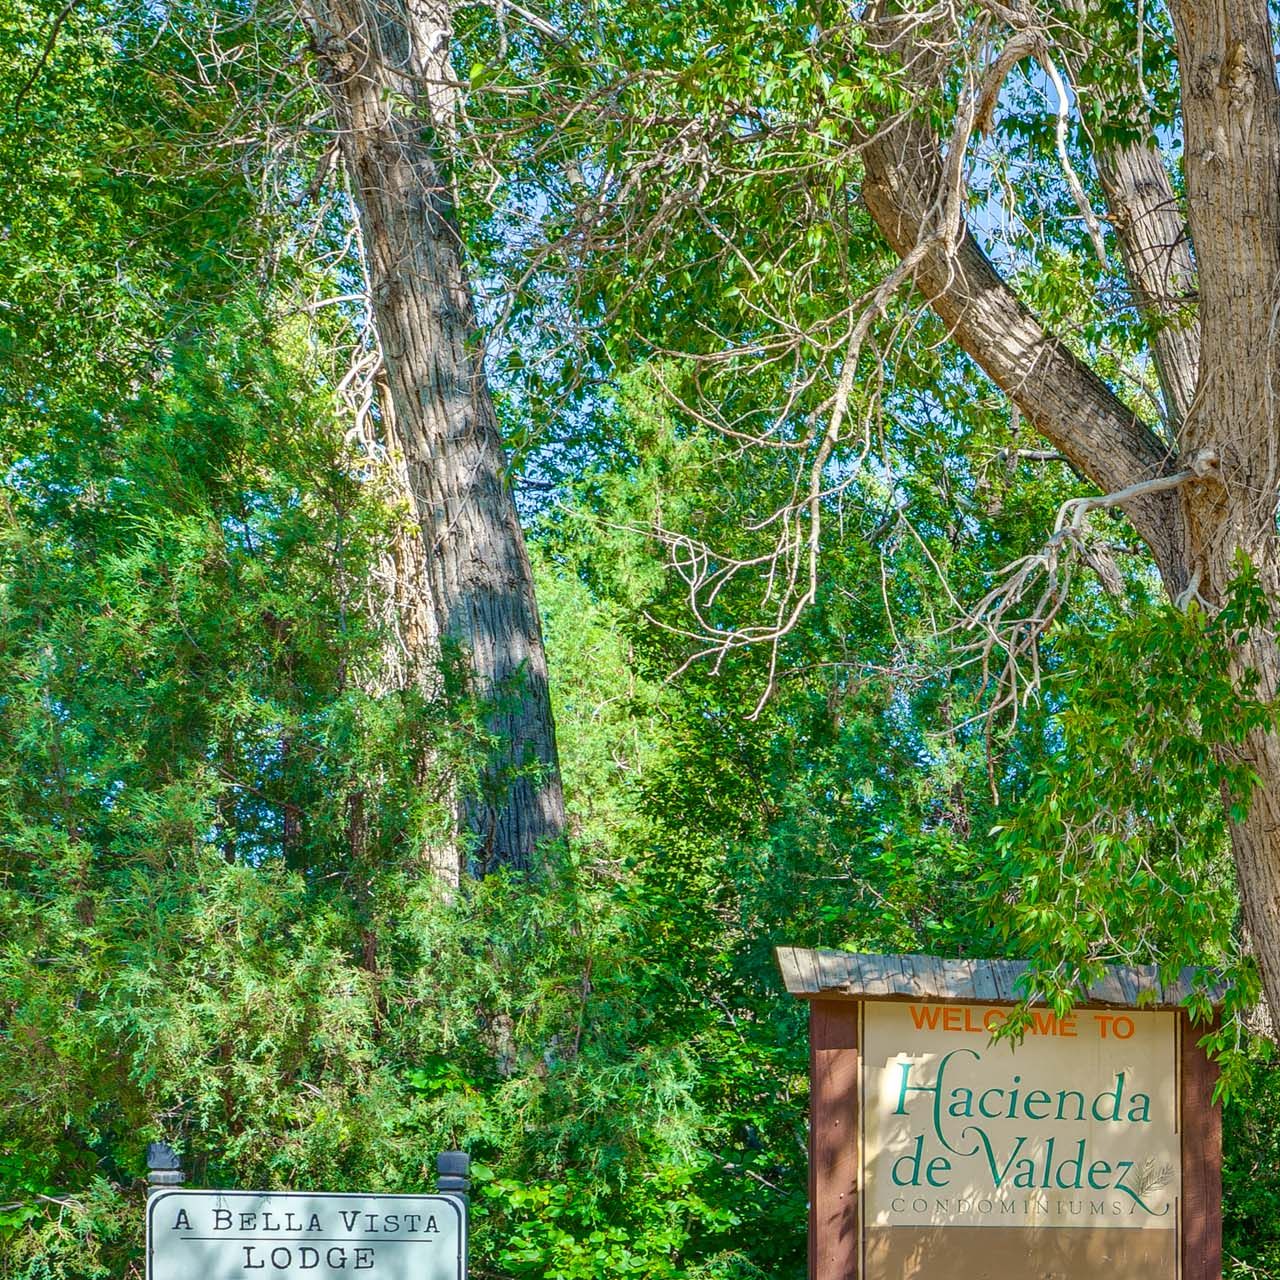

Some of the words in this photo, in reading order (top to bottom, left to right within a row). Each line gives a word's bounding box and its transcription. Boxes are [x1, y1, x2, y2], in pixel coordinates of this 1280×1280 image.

[908, 1005, 1078, 1038] WELCME
[1094, 1014, 1136, 1040] TO
[891, 1048, 1152, 1157] Hacienda
[891, 1135, 952, 1188] de
[961, 1126, 1170, 1217] Valdez
[171, 1208, 193, 1231] A
[212, 1209, 323, 1232] BELLA
[338, 1210, 441, 1233] VISTA
[890, 1197, 1123, 1217] CONDOMINIUMS
[242, 1246, 376, 1270] LODGE
